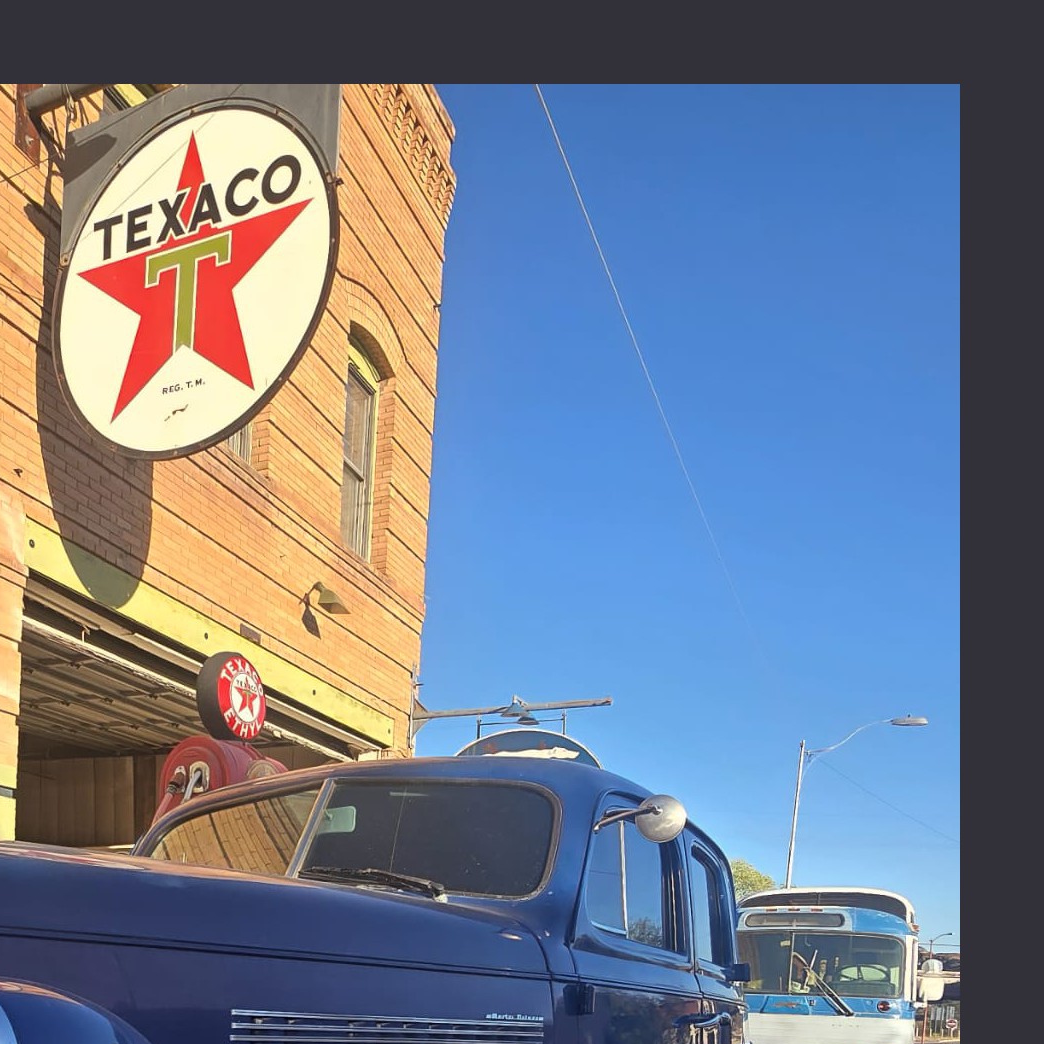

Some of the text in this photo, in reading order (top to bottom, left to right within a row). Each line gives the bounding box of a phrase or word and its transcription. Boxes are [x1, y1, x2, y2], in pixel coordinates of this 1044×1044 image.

[93, 154, 302, 261] TEXACO
[145, 230, 233, 353] T
[162, 383, 184, 395] REG.
[220, 658, 264, 696] TEXACO
[223, 707, 262, 738] ETHYL
